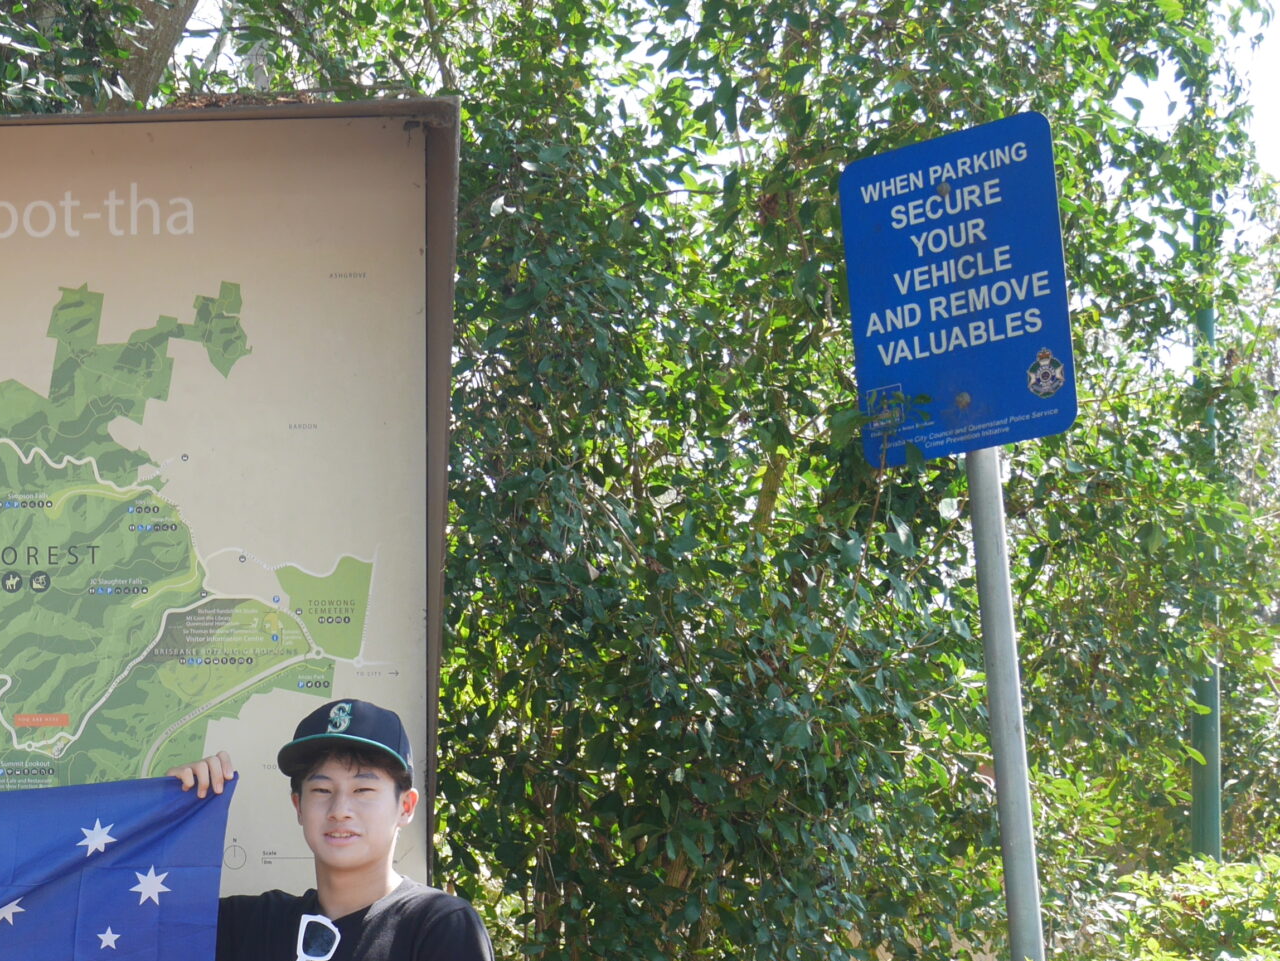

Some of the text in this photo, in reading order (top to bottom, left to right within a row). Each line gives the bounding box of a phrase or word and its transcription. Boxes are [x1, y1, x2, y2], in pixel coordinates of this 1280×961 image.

[860, 142, 1028, 204] WHEN PARKING
[890, 178, 1002, 230] SECURE
[910, 218, 988, 257] YOUR
[893, 245, 1012, 296] VEHICLE
[865, 270, 1051, 337] AND REMOVE
[877, 308, 1043, 367] VALUABLES
[924, 426, 1010, 449] Crime Prevention Initiative
[928, 428, 954, 441] Council
[954, 426, 967, 436] and
[968, 417, 1008, 432] Queensland
[1009, 412, 1031, 424] Police
[1031, 407, 1059, 419] Service
[308, 599, 356, 607] TOOWONG
[308, 607, 355, 615] CEMETERY
